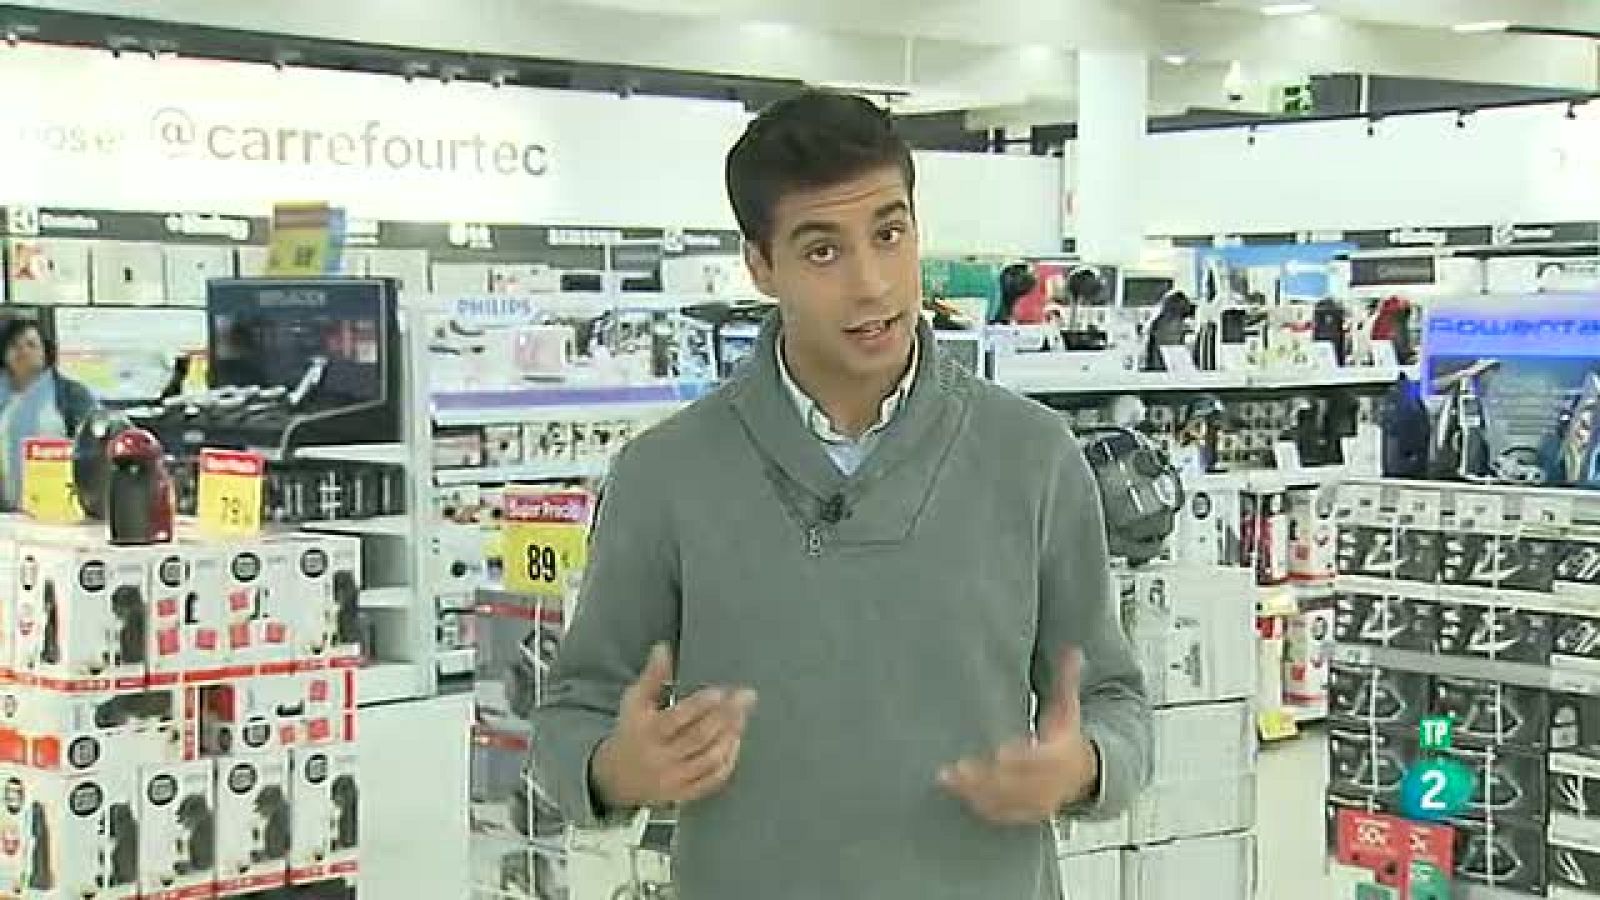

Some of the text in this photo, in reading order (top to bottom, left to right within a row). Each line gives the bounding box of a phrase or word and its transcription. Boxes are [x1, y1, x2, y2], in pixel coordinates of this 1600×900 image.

[150, 106, 548, 176] @carrefourtec
[457, 297, 532, 316] PHILIPS
[527, 543, 556, 583] 89
